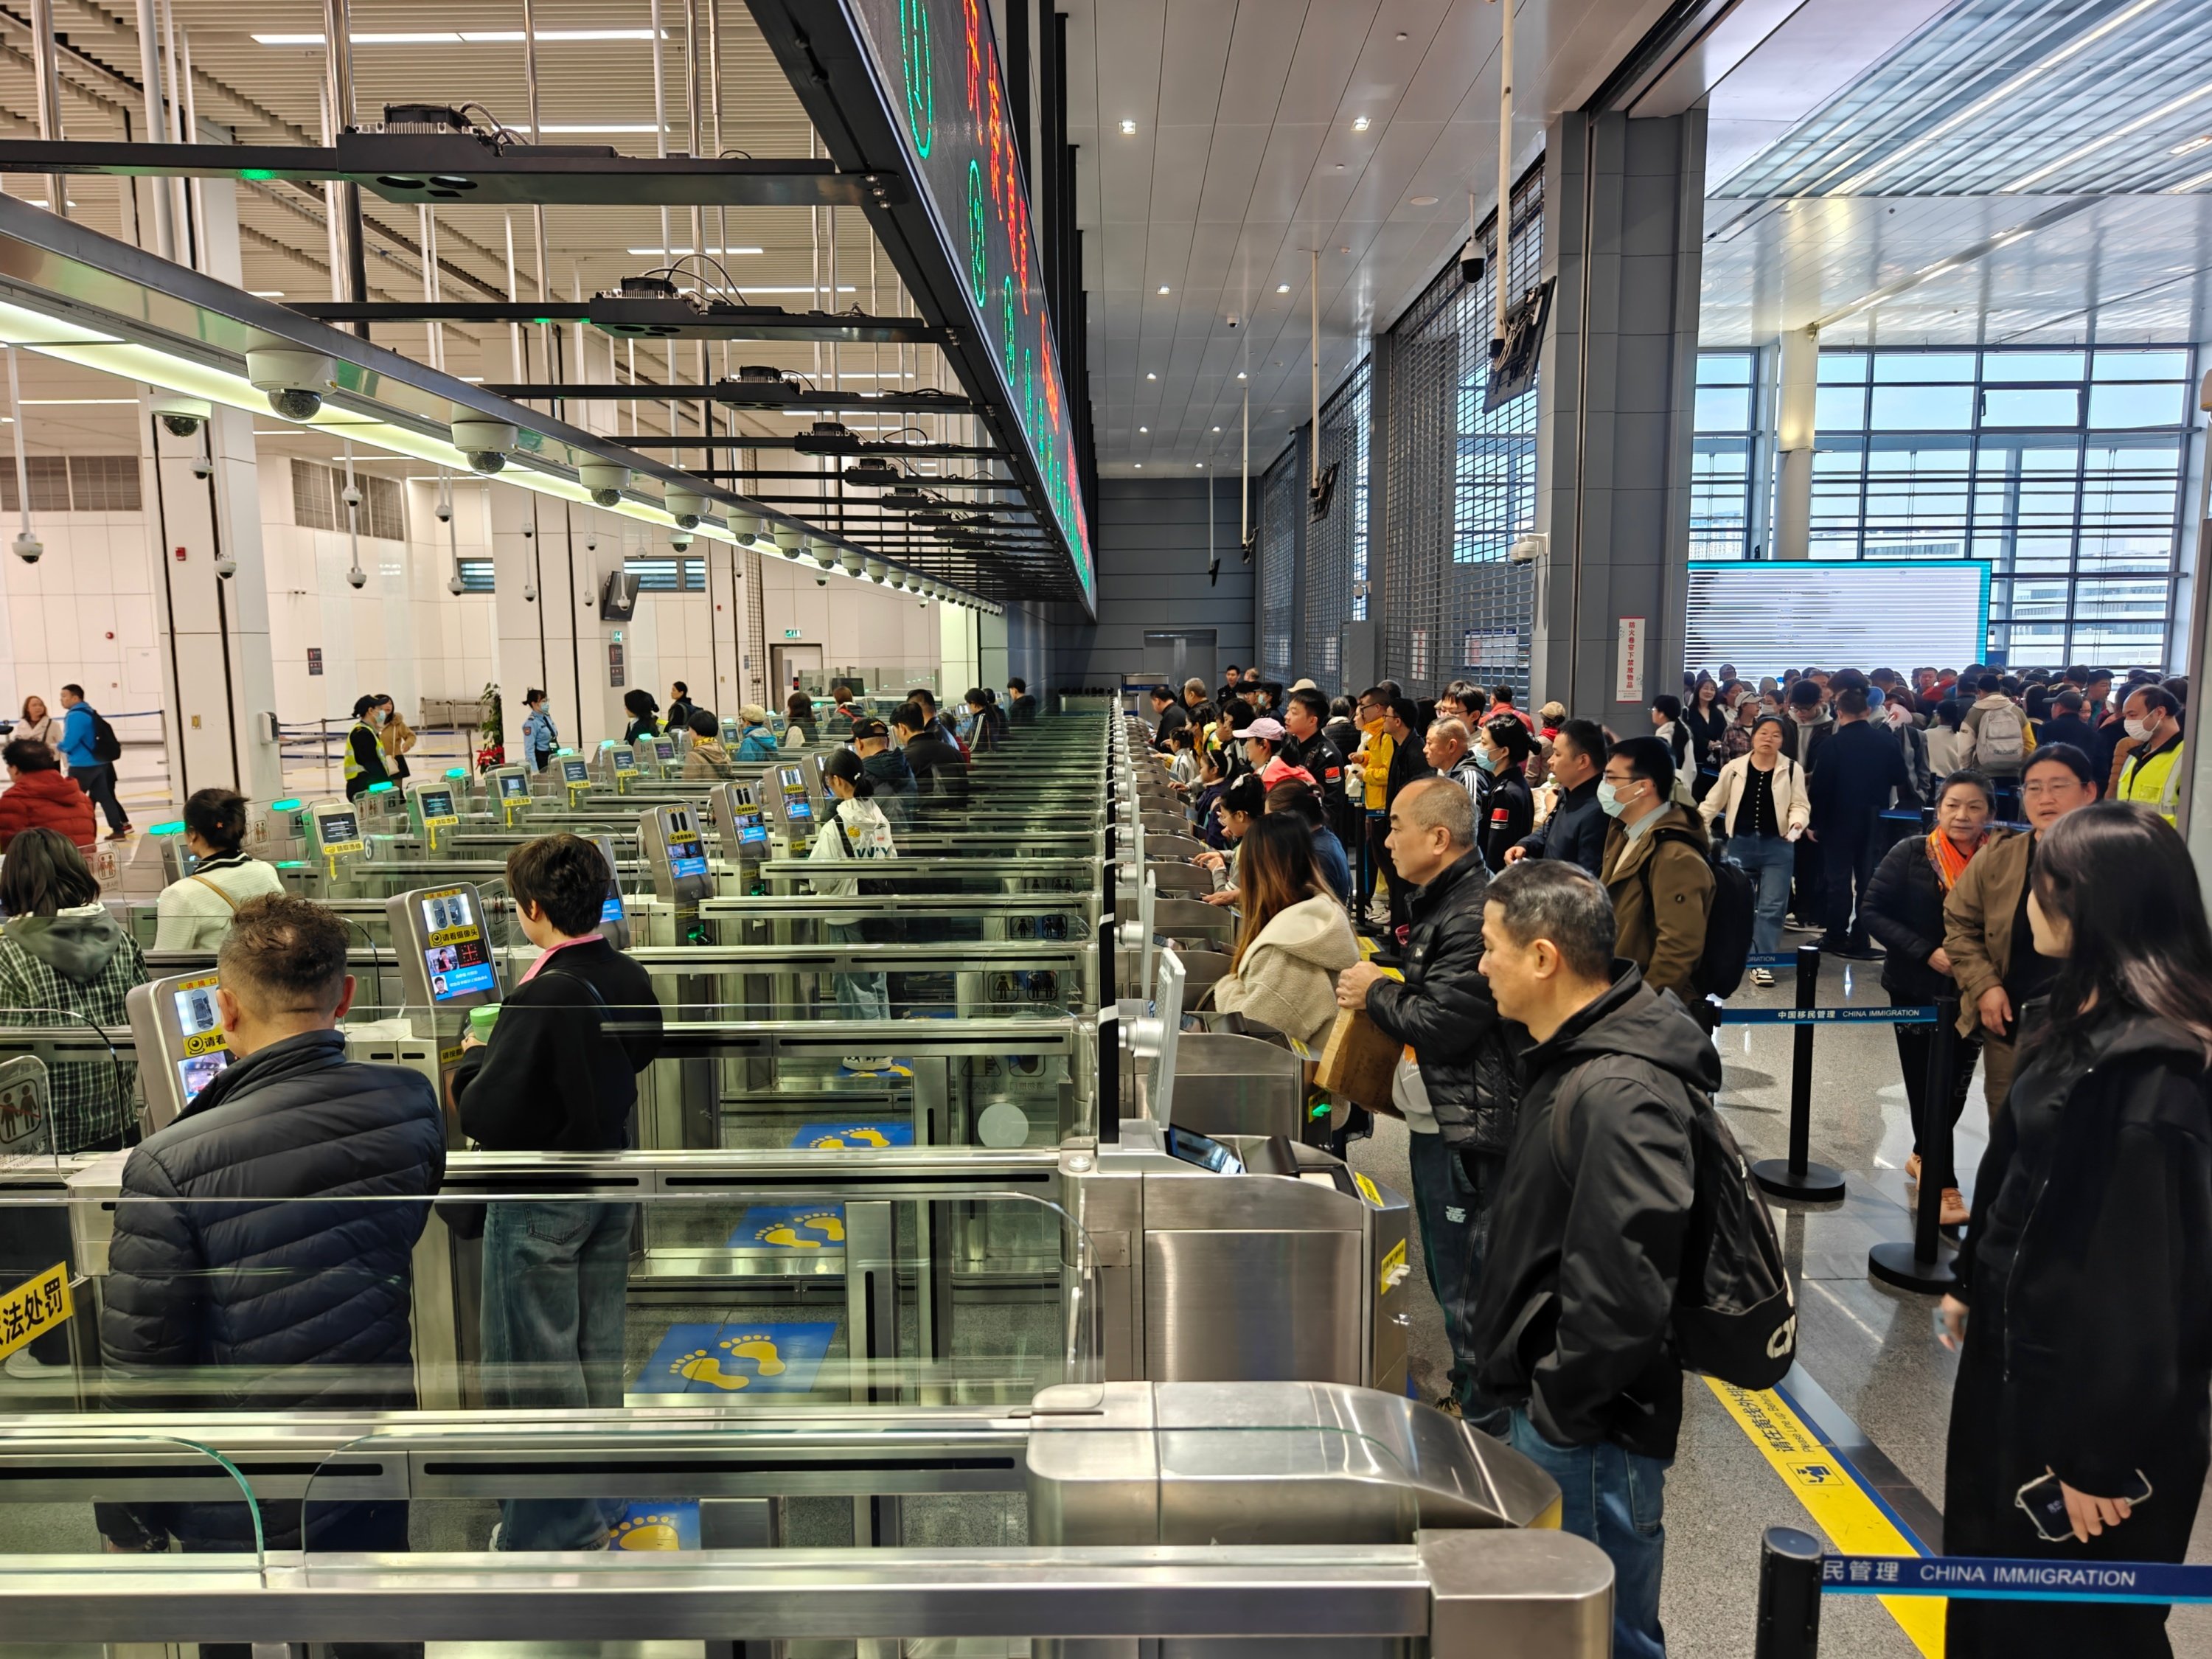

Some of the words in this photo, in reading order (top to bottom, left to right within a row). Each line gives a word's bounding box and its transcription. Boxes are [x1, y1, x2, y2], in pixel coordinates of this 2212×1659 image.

[1626, 621, 1636, 689] 防火卷帘下禁放物品
[442, 928, 479, 942] 请看摄像头
[1778, 1009, 1836, 1020] 中国移民管理
[1868, 1009, 1920, 1018] IMMIGRATION
[1822, 1559, 1899, 1582] 民管理
[1920, 1564, 1986, 1582] CHINA
[1993, 1566, 2136, 1587] IMMIGRATION
